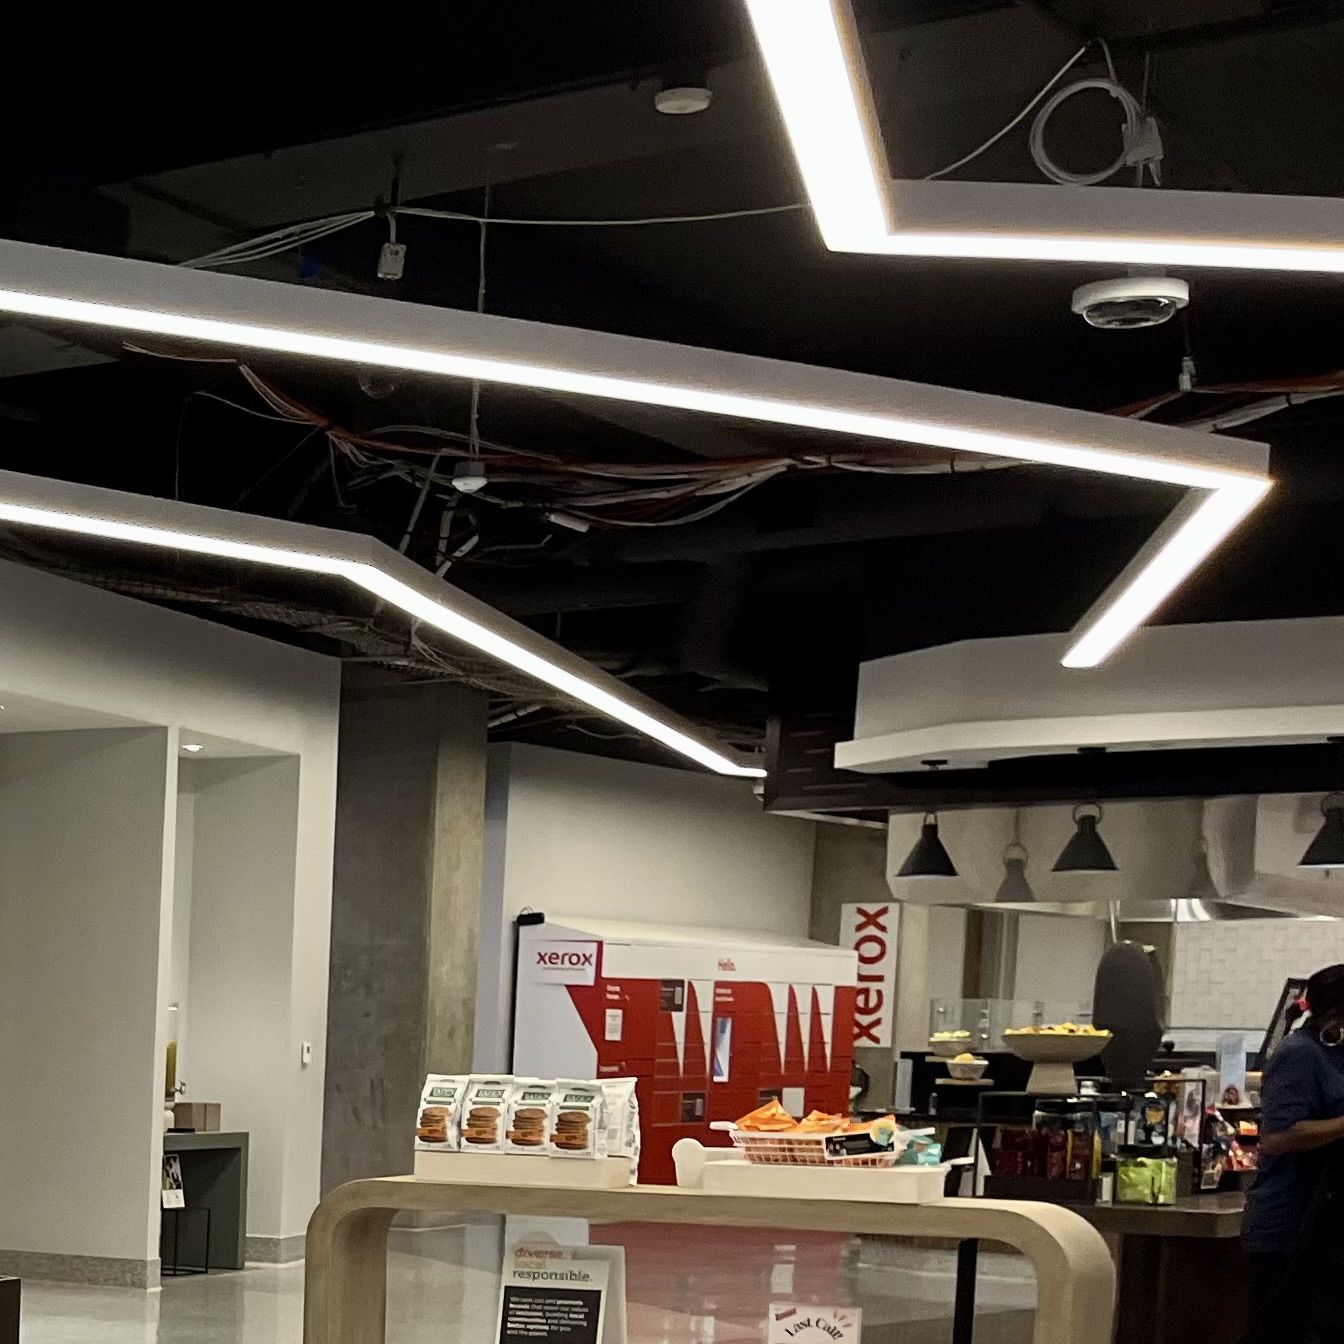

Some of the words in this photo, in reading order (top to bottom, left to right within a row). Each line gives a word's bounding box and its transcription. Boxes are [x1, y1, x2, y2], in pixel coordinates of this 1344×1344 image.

[536, 951, 593, 967] xerox
[852, 905, 889, 1045] xerox
[513, 1270, 593, 1282] responsible.
[784, 1317, 813, 1337] Last
